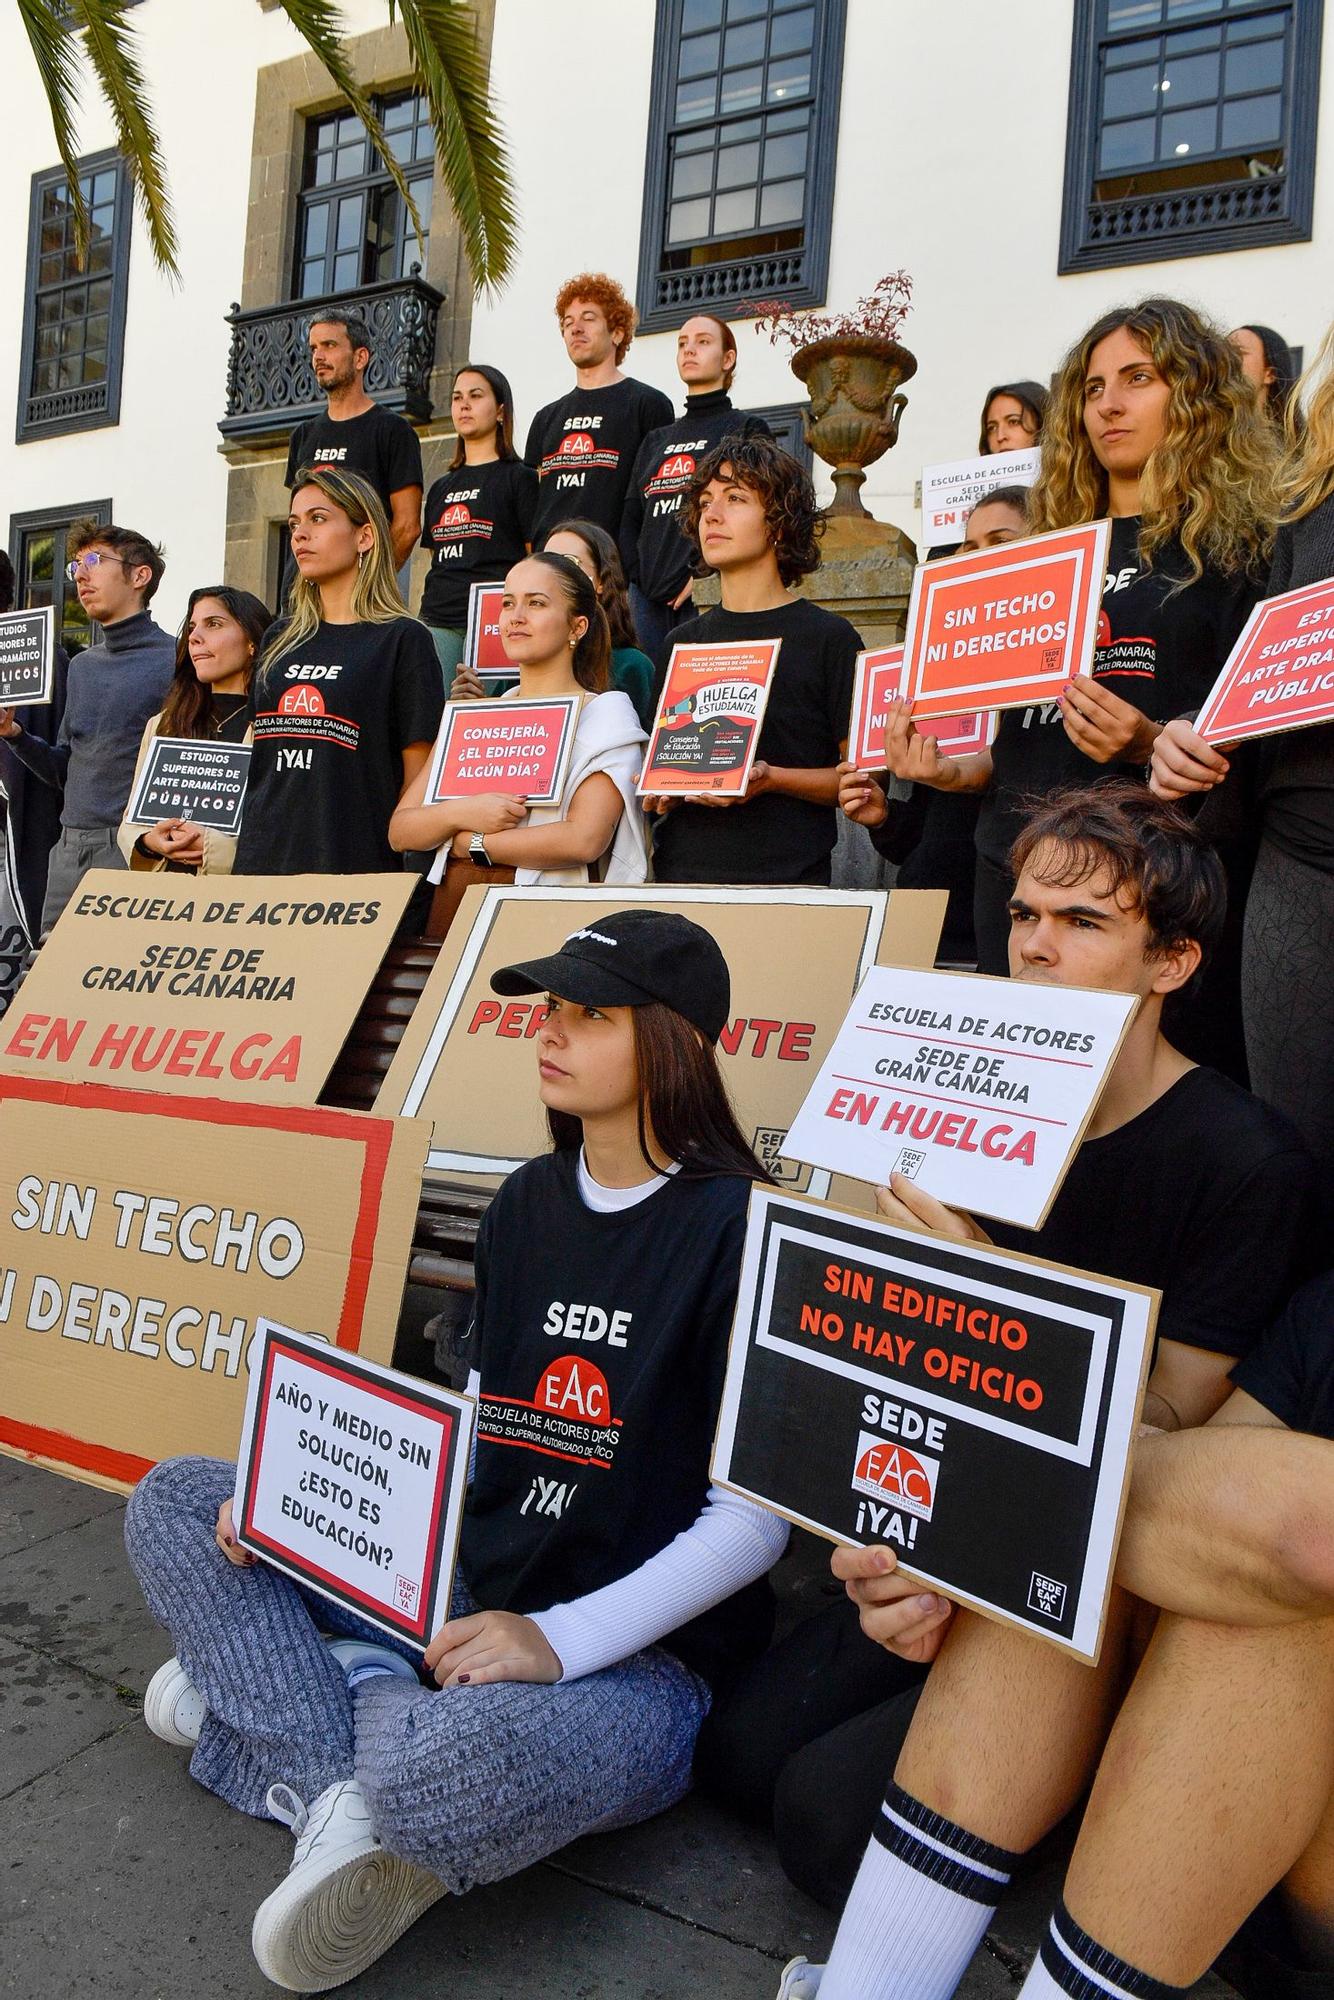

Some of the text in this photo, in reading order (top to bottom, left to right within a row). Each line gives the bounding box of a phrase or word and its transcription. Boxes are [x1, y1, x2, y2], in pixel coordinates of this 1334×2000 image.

[563, 416, 603, 430] SEDE
[564, 436, 590, 454] EAC
[664, 440, 708, 454] SEDE
[314, 448, 348, 461] SEDE
[662, 458, 692, 476] EAC
[932, 462, 1032, 486] ESCUELA DE ACTORES
[556, 472, 586, 490] ¡YA!
[962, 484, 986, 494] SEDE
[444, 488, 480, 503] SEDE
[946, 494, 972, 504] GRAN
[444, 506, 466, 524] EAC
[933, 512, 956, 526] EN
[439, 543, 463, 562] ¡YA!
[944, 590, 1056, 629] SIN TECHO
[27, 636, 38, 646] DE
[927, 643, 948, 663] NI
[953, 620, 1066, 659] DERECHOS
[1107, 646, 1156, 661] CANARIAS
[284, 664, 342, 680] SEDE
[1096, 660, 1155, 672] ARTE DRAMÁTICO
[1237, 648, 1334, 687] ARTE DRA
[284, 688, 319, 713] EAC
[703, 686, 758, 704] HUELGA
[698, 700, 757, 716] ESTUDIANTIL
[284, 718, 312, 726] ACTORES
[313, 718, 322, 727] DE
[324, 720, 360, 739] CANARIAS
[871, 714, 887, 728] NI
[463, 723, 550, 741] CONSEJERÍA,
[180, 751, 230, 764] ESTUDIOS
[276, 748, 313, 772] ¡YA!
[458, 744, 546, 762] ¿EL EDIFICIO
[656, 752, 692, 761] ¡SOLUCIÓN
[162, 764, 240, 780] SUPERIORES DE
[456, 762, 540, 778] ALGÚN DÍA?
[152, 776, 240, 794] ARTE DRAMÁTICO
[148, 790, 235, 812] PÚBLICOS
[74, 894, 382, 926] ESCUELA DE ACTORES
[140, 944, 265, 973] SEDE DE
[82, 966, 297, 1001] GRAN CANARIA
[868, 1002, 1096, 1054] ESCUELA DE ACTORES
[4, 1014, 303, 1084] EN HUELGA
[914, 1046, 1004, 1078] SEDE DE
[874, 1058, 1030, 1104] GRAN CANARIA
[825, 1088, 1037, 1167] EN HUELGA
[901, 1159, 916, 1168] EAC
[902, 1151, 922, 1162] SEDE
[765, 1160, 783, 1174] YA
[901, 1166, 909, 1174] YA
[12, 1174, 306, 1280] SIN TECHO
[823, 1264, 1028, 1352] SIN EDIFICIO
[543, 1301, 633, 1348] SEDE
[800, 1304, 1044, 1412] NO HAY OFICIO
[545, 1364, 604, 1418] EAC
[276, 1382, 432, 1470] AÑO Y MEDIO SIN
[530, 1414, 542, 1428] DE
[544, 1418, 590, 1440] ACTORES
[861, 1394, 947, 1452] SEDE
[505, 1427, 541, 1443] SUPERIOR
[542, 1436, 584, 1454] AUTORIZADO
[584, 1446, 594, 1456] DE
[298, 1429, 392, 1496] SOLUCIÓN,
[866, 1448, 926, 1502] EAC
[300, 1471, 381, 1525] ¿ESTO ES
[281, 1494, 394, 1571] EDUCACIÓN?
[856, 1501, 918, 1550] ¡YA!
[398, 1579, 416, 1595] SEDE
[399, 1590, 412, 1602] EAC
[1035, 1578, 1062, 1596] SEDE
[1037, 1588, 1057, 1604] EAC
[400, 1598, 410, 1610] YA
[1039, 1599, 1052, 1613] YA
